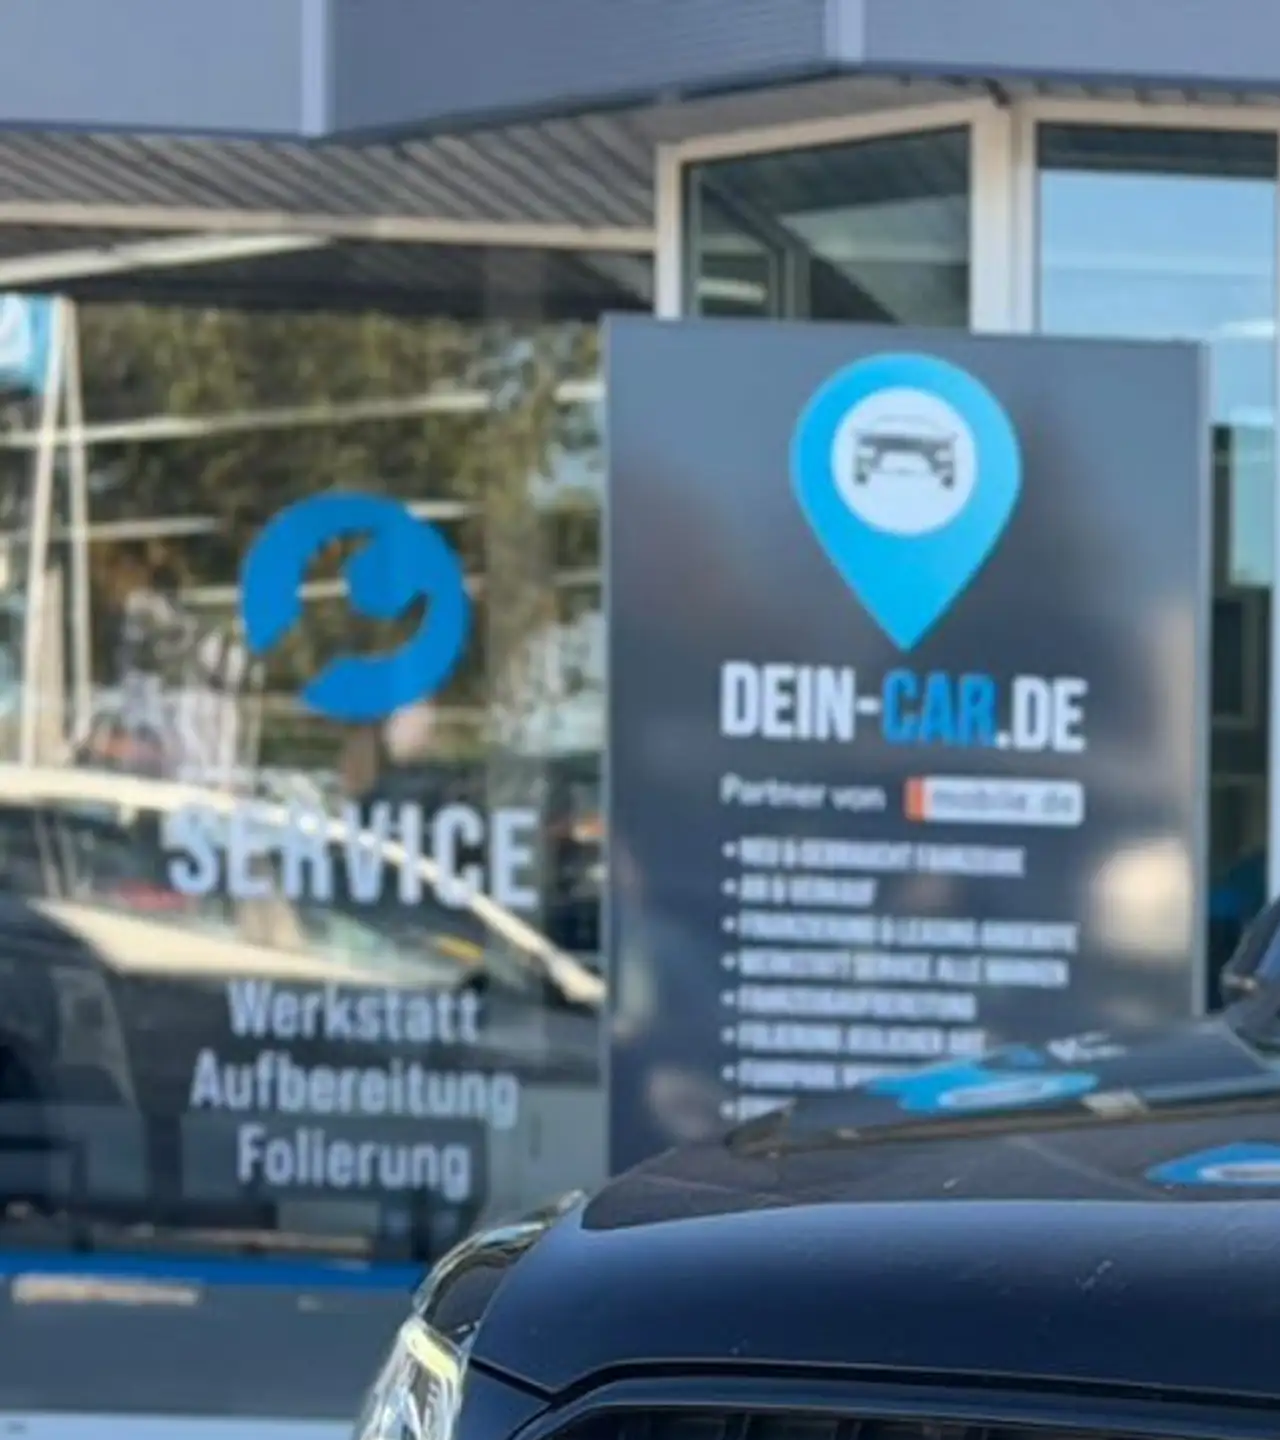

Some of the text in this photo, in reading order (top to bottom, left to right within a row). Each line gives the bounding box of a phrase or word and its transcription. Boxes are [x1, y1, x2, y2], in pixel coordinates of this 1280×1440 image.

[720, 660, 1089, 753] DEIN-CAR.DE
[163, 798, 540, 909] SERVICE
[226, 979, 480, 1043] Werkstatt
[190, 1048, 519, 1130] Aufbereitung
[236, 1123, 472, 1201] Folierung
